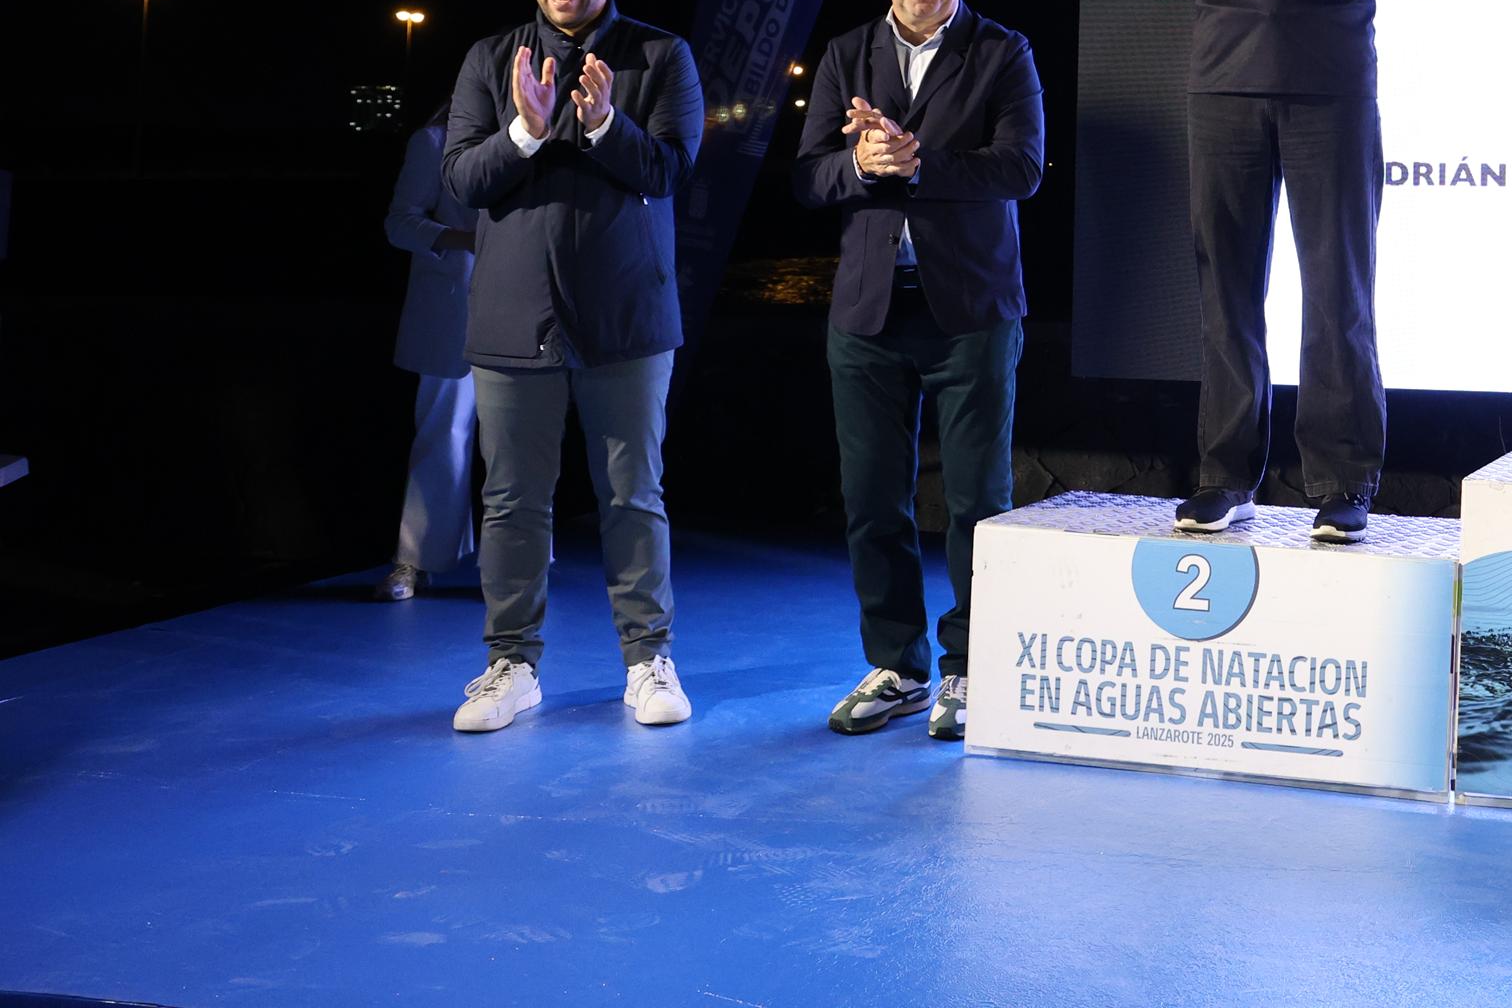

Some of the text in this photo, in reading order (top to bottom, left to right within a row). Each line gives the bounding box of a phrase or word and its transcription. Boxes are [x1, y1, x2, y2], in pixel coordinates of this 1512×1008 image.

[1385, 156, 1507, 187] DRIÁN
[1172, 553, 1212, 613] 2
[1015, 631, 1368, 698] XI COPA DE NATACION
[1019, 673, 1362, 741] EN AGUAS ABIERTAS
[1136, 726, 1235, 749] LANZAROTE 2025
